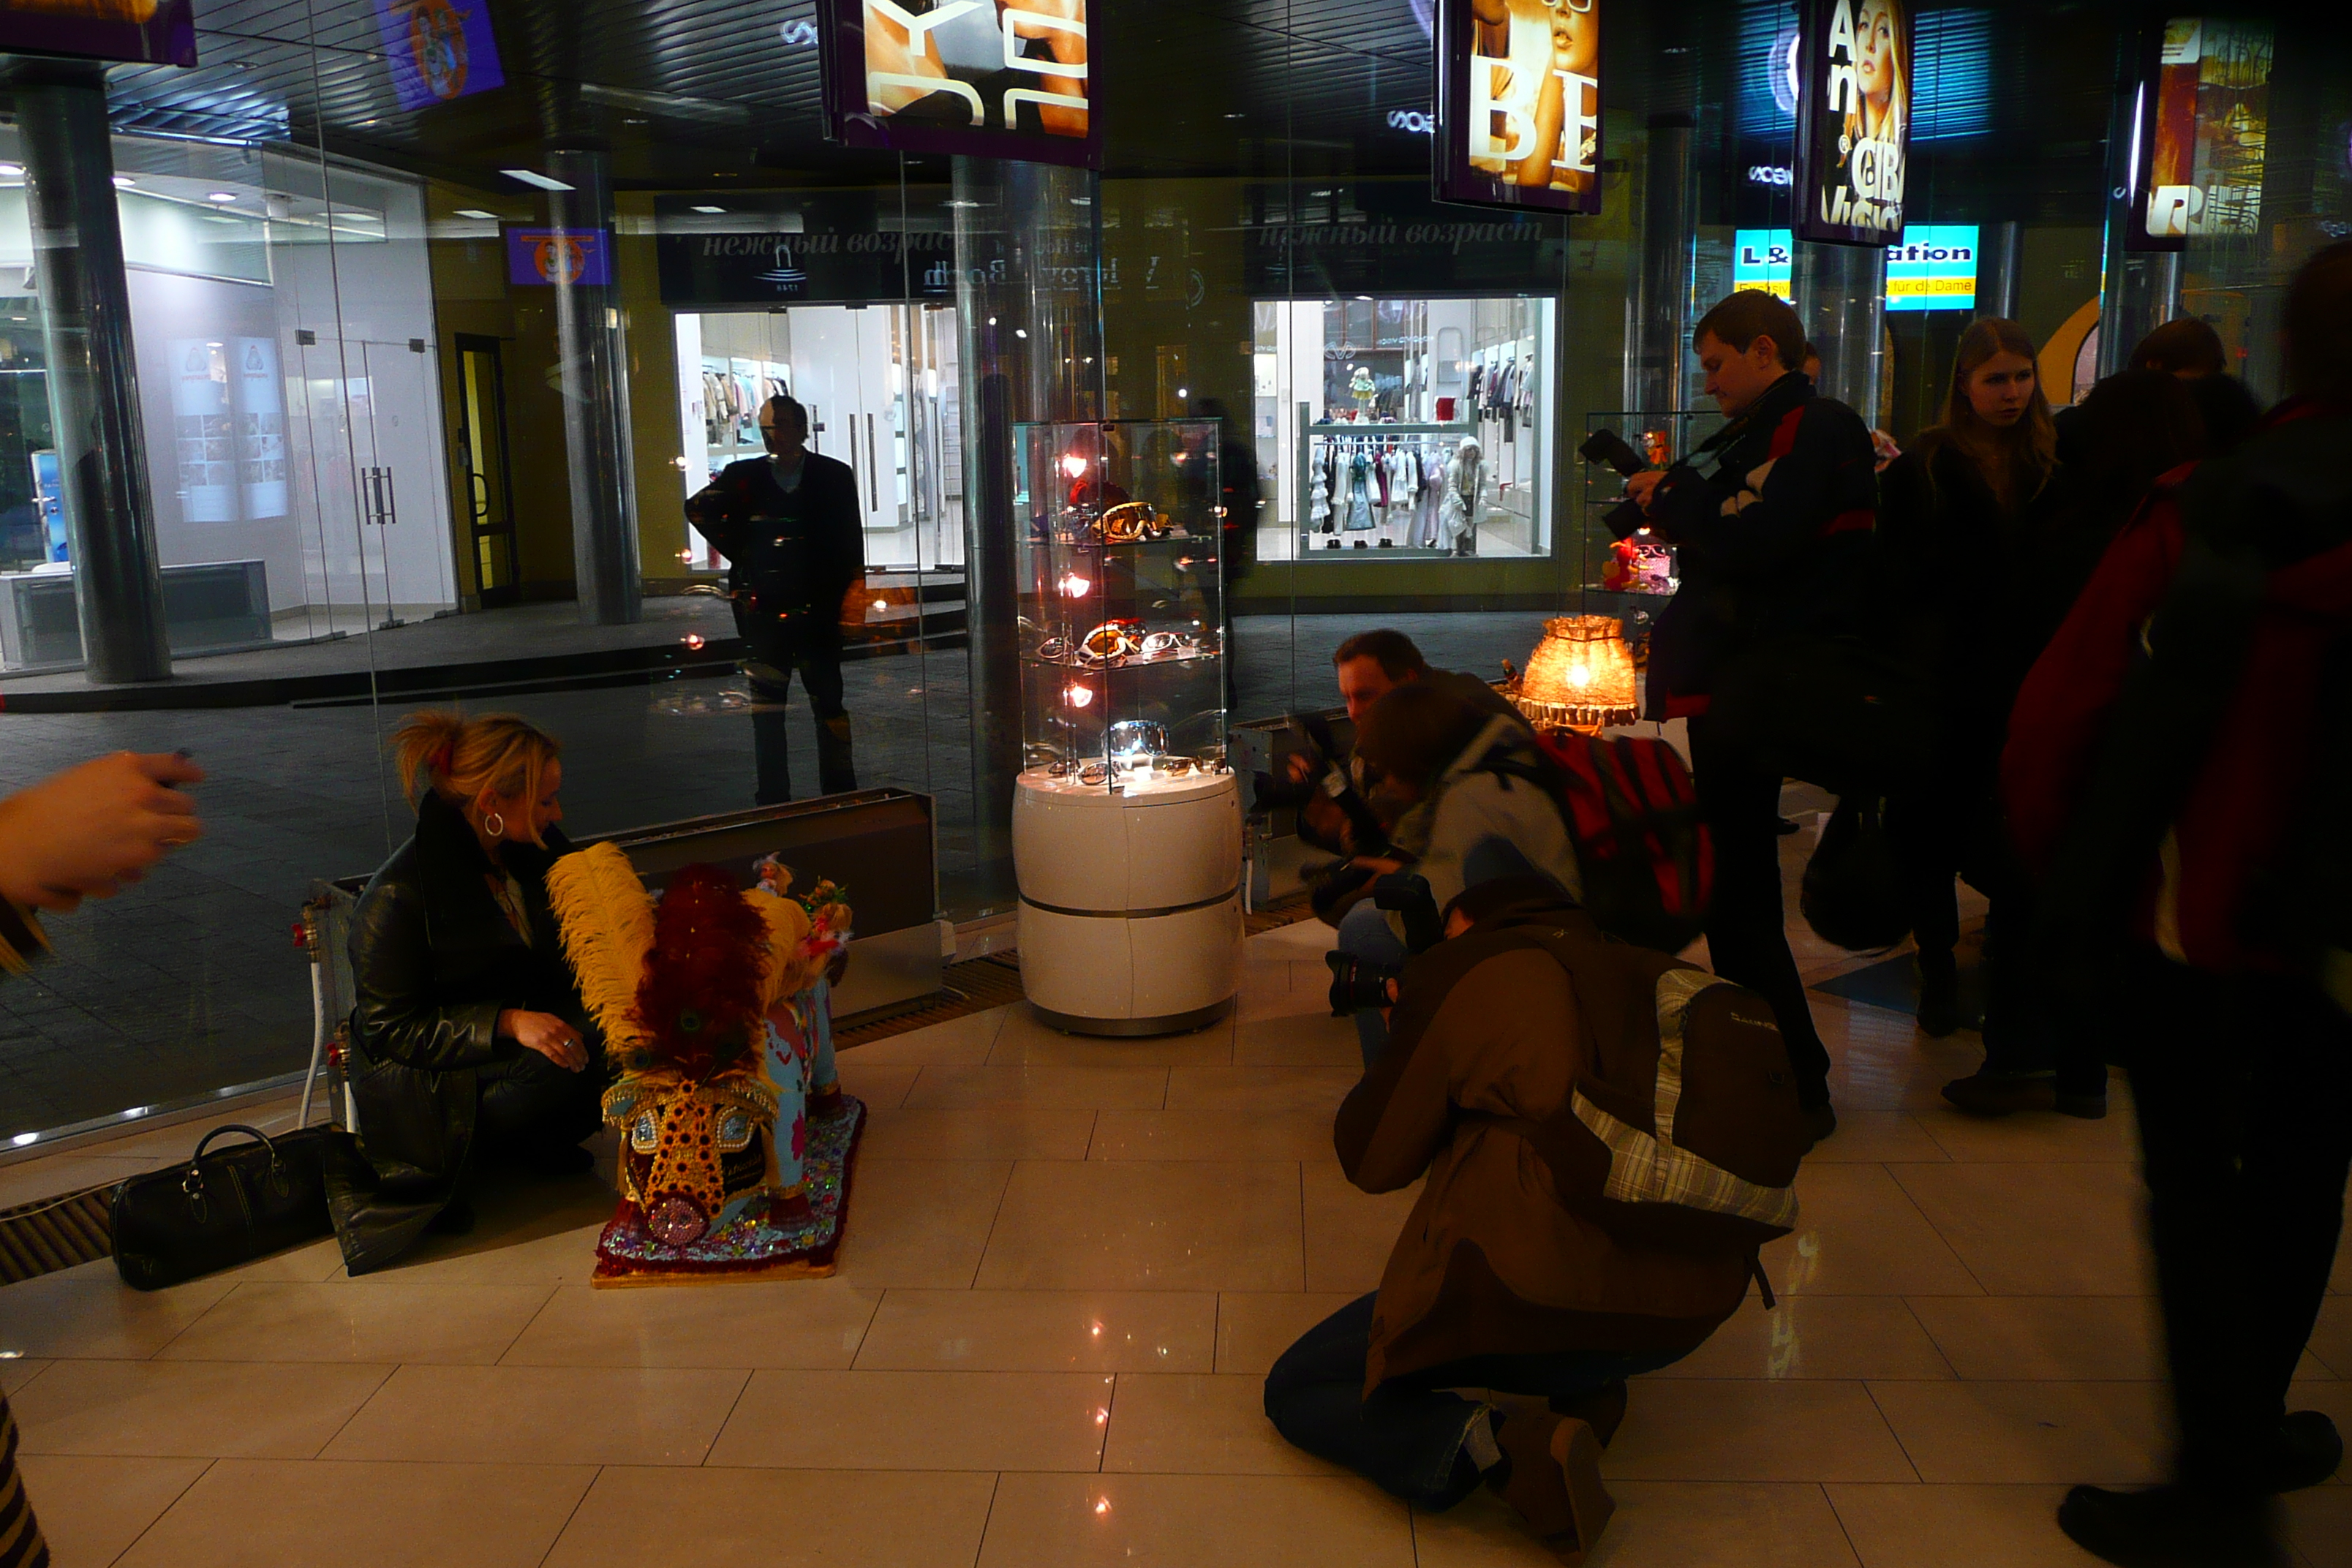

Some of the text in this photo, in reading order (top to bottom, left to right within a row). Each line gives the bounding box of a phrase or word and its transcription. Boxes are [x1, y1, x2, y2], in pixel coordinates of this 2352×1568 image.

[847, 231, 954, 265] возрас
[1405, 221, 1545, 255] возраст
[1744, 247, 1760, 264] L
[1768, 246, 1790, 264] &
[1893, 280, 1911, 292] für
[1934, 279, 1972, 292] Dame
